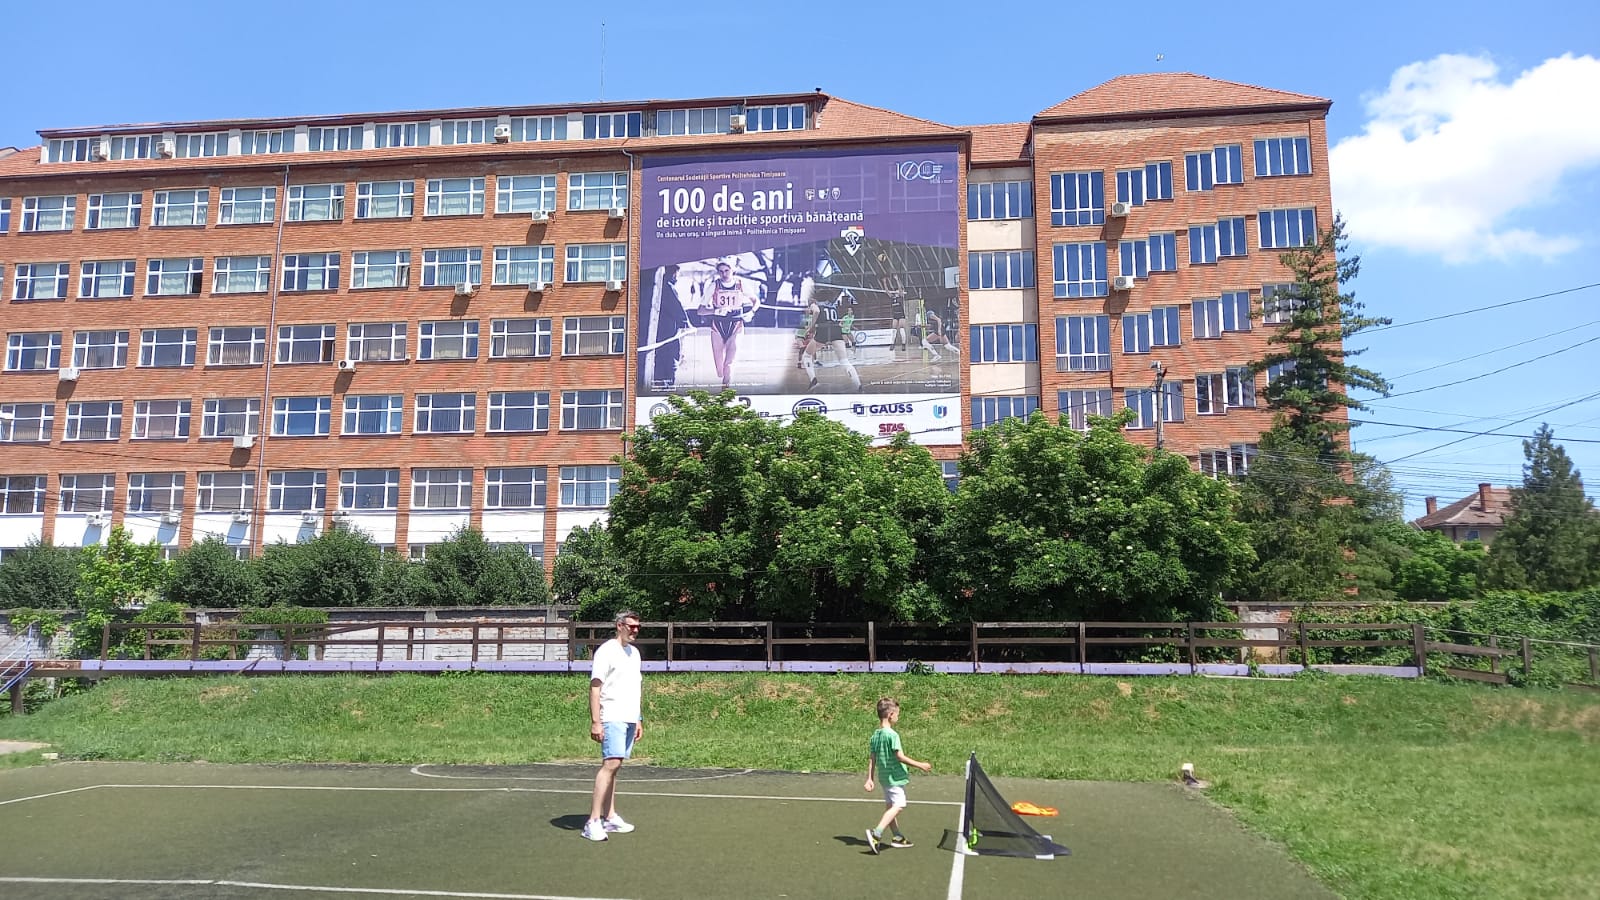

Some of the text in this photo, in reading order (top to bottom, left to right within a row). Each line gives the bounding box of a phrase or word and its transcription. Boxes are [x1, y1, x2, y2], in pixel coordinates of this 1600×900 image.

[658, 182, 793, 214] 100 de ani
[656, 217, 670, 228] de
[672, 216, 705, 228] istorie
[718, 214, 757, 228] tradiție
[760, 212, 803, 226] sportivă
[806, 210, 864, 225] bănățeană
[747, 227, 778, 235] Politehnica
[719, 295, 736, 306] 311
[823, 308, 838, 321] 10
[869, 403, 914, 414] GAUSS
[878, 422, 905, 433] STAS
